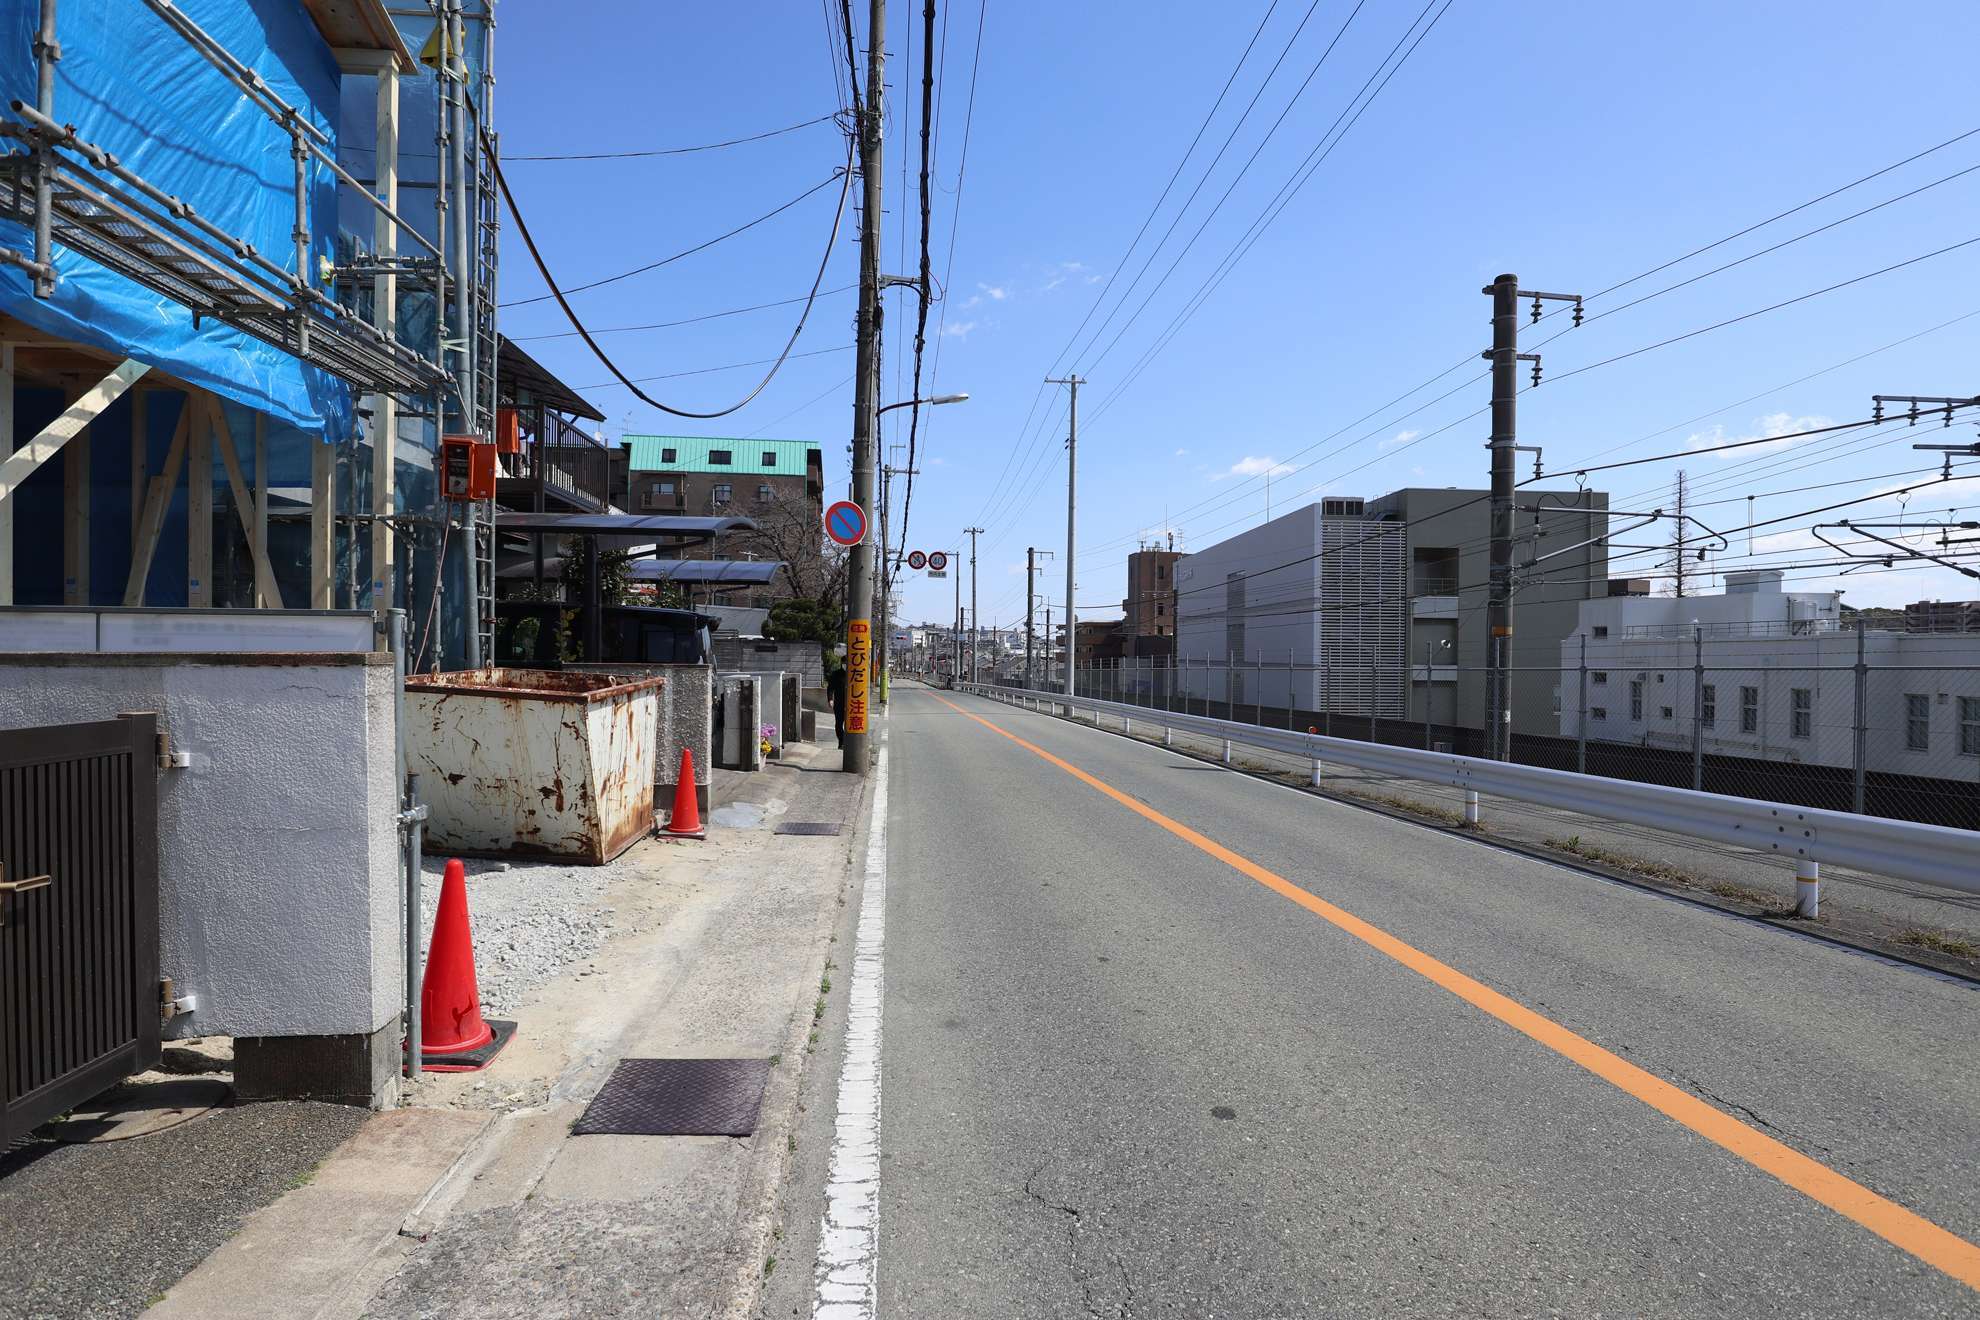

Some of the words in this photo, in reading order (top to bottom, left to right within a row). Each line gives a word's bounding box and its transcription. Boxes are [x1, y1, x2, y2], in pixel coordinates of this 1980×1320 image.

[932, 556, 943, 566] 40
[849, 636, 866, 731] とびだし注意
